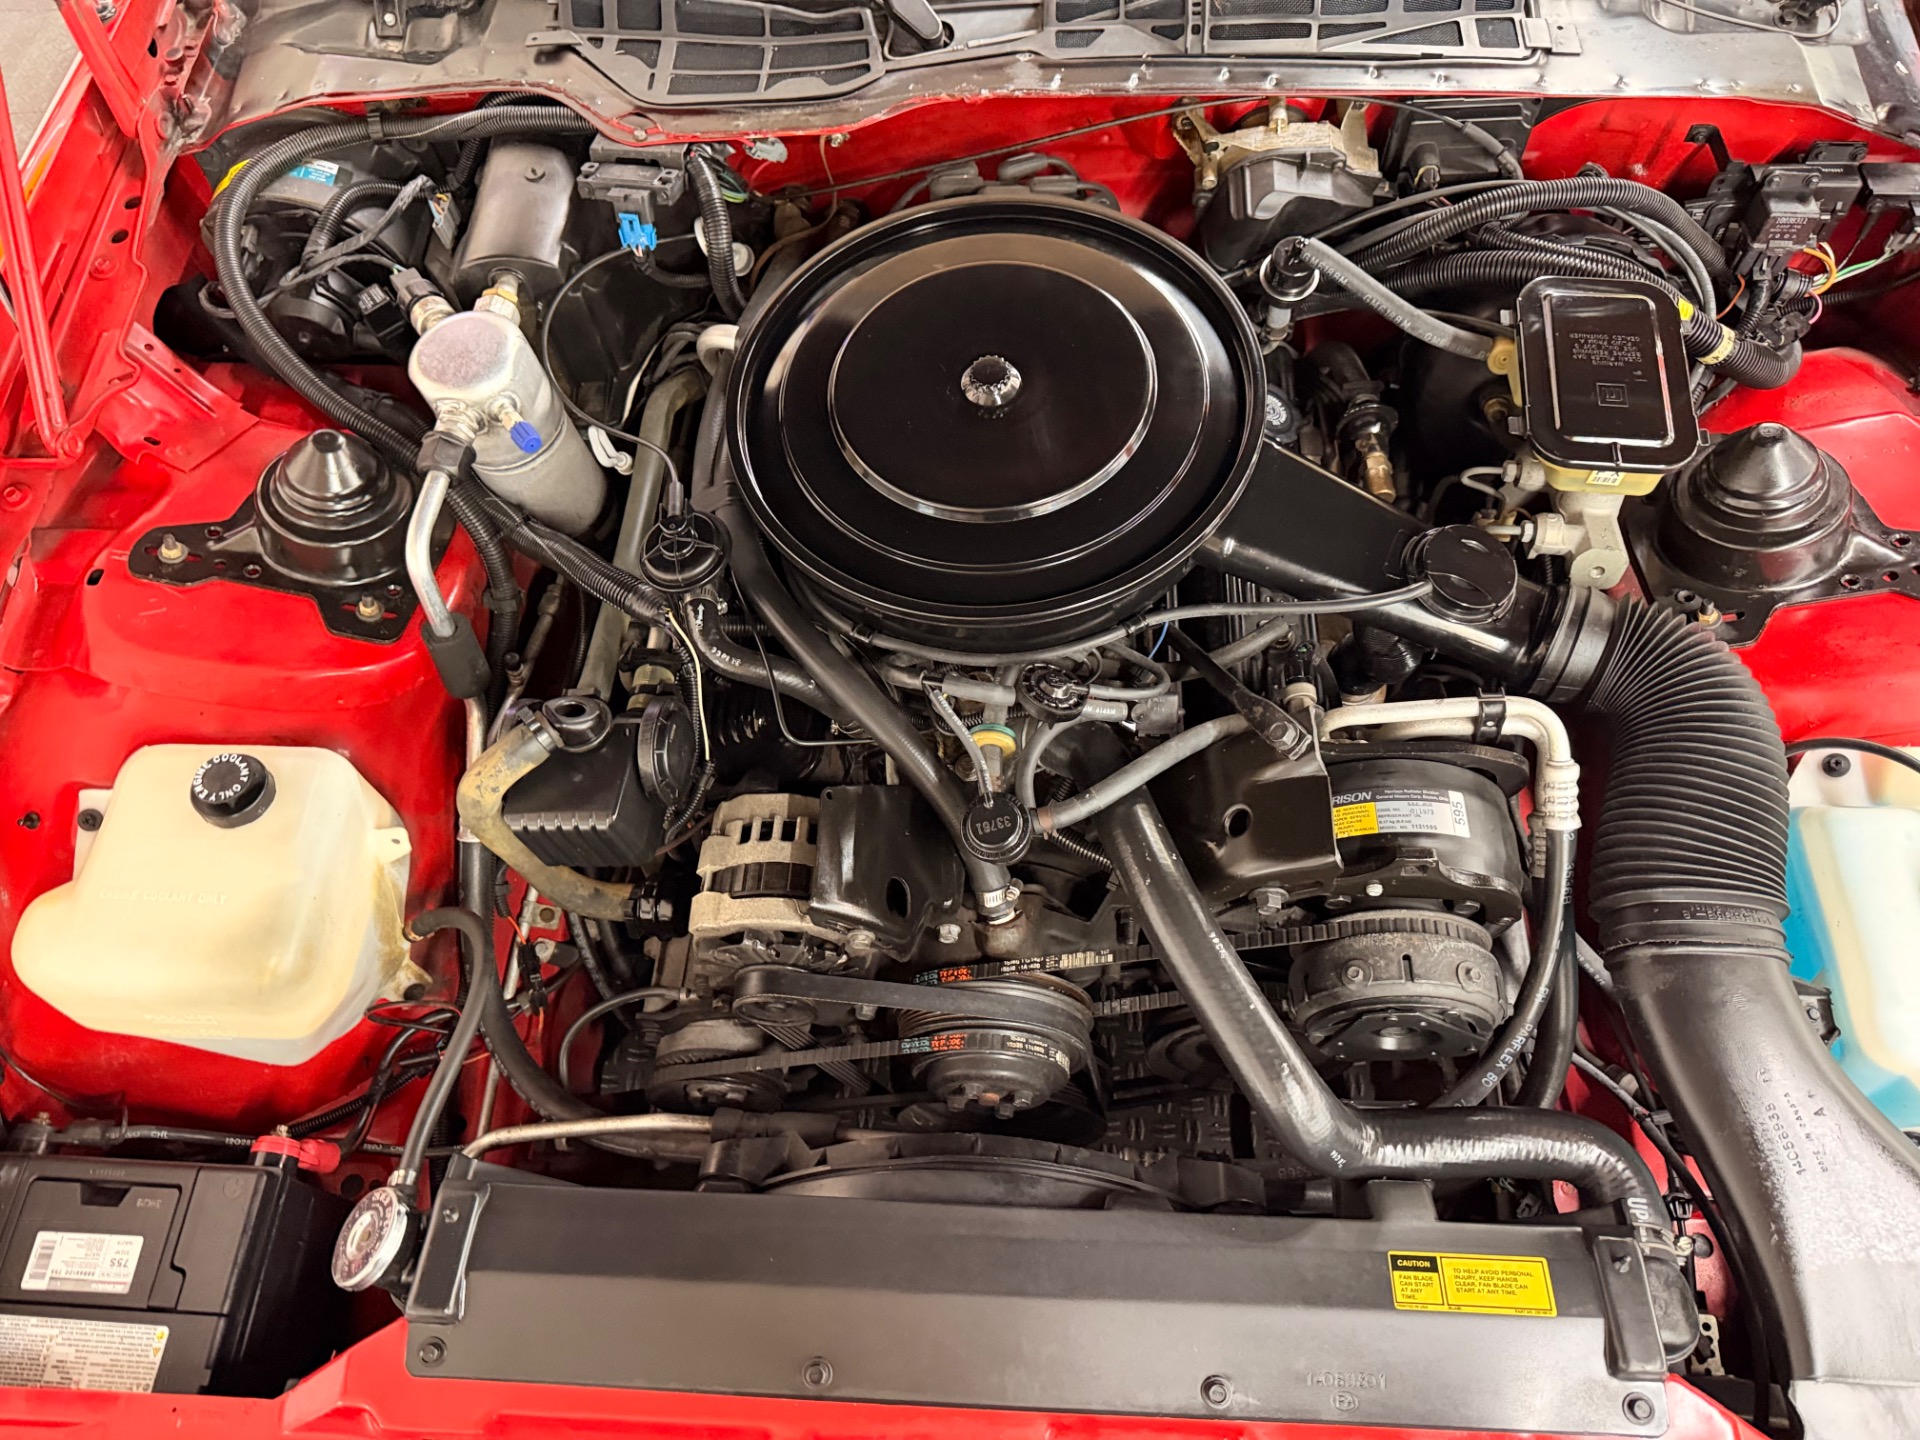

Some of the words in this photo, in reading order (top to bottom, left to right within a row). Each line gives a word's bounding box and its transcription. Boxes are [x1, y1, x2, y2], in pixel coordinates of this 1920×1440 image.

[192, 761, 212, 799] ENGINE
[212, 753, 250, 783] COOLANT
[208, 783, 242, 802] ONLY
[1453, 801, 1466, 826] 595
[1495, 1023, 1534, 1070] PARFLEX
[1481, 1071, 1498, 1088] 80
[1396, 1259, 1431, 1268] CAUTION
